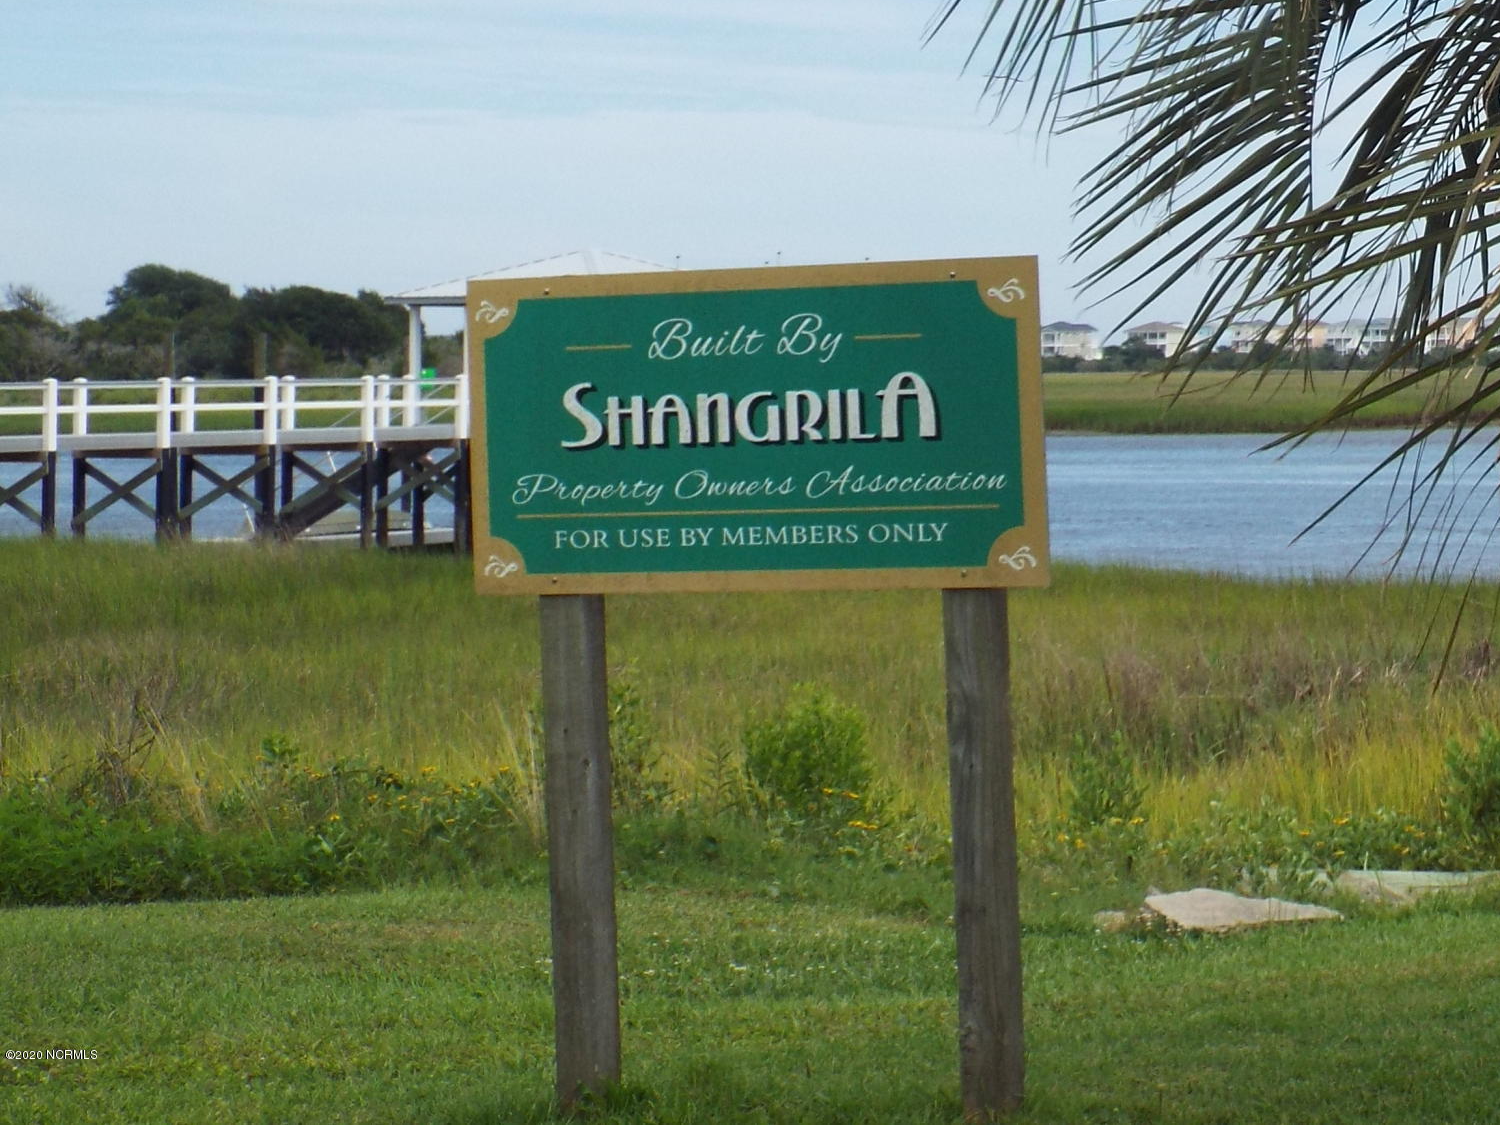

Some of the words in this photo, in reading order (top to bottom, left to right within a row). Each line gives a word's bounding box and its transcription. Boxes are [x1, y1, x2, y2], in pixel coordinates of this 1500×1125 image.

[648, 318, 764, 361] Built
[776, 313, 843, 363] By
[560, 371, 937, 448] SHANGRILA
[512, 473, 664, 506] Property
[674, 469, 796, 499] Owners
[806, 465, 1007, 499] Association
[555, 529, 609, 549] FOR
[618, 528, 671, 548] USE
[681, 527, 713, 547] BY
[722, 525, 859, 546] MEMBERS
[868, 522, 948, 542] ONLY
